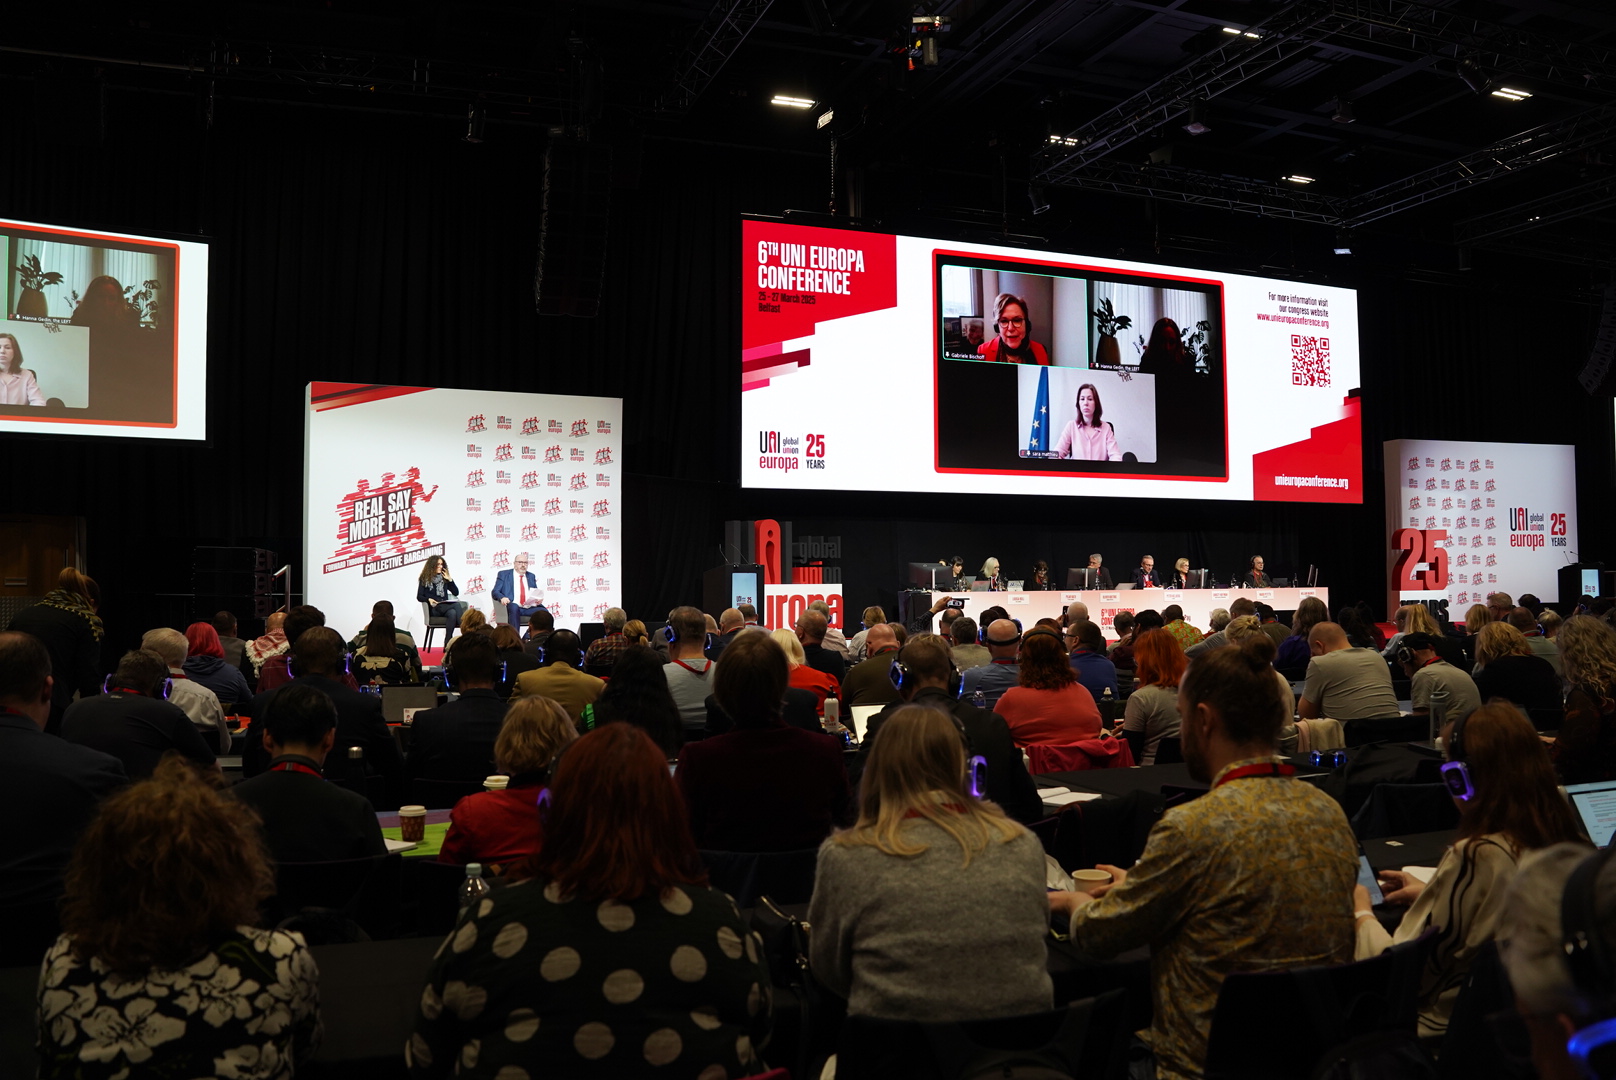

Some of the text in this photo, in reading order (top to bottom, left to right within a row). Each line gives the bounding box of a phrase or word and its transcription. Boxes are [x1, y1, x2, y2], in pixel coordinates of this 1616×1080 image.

[780, 242, 806, 267] UNI
[810, 246, 864, 272] EUROPA
[758, 265, 850, 295] CONFERENCE
[758, 292, 766, 300] 25
[772, 292, 780, 302] 27
[780, 293, 800, 303] March
[801, 295, 816, 304] 2025
[1290, 294, 1317, 306] information
[1318, 298, 1328, 307] visit
[758, 303, 780, 312] Belfast
[1288, 305, 1309, 315] congress
[1310, 308, 1328, 317] website
[1257, 313, 1329, 329] www.unieuropaconference.org
[783, 437, 799, 446] global
[783, 446, 799, 454] union
[806, 434, 825, 458] 25
[760, 456, 798, 473] europa
[806, 460, 825, 469] YEARS
[1274, 474, 1348, 490] unieuropaconference.org
[354, 489, 411, 521] REAL SAY
[349, 509, 411, 542] MORE PAY
[1530, 513, 1544, 523] global
[1530, 522, 1544, 531] union
[1550, 513, 1566, 536] 25
[799, 536, 842, 564] global
[1510, 534, 1544, 551] europa
[1551, 537, 1566, 546] YEARS
[365, 545, 443, 575] COLLECTIVE BARGAINING
[1396, 528, 1448, 590] 25
[798, 561, 842, 584] union
[764, 594, 844, 630] uroa
